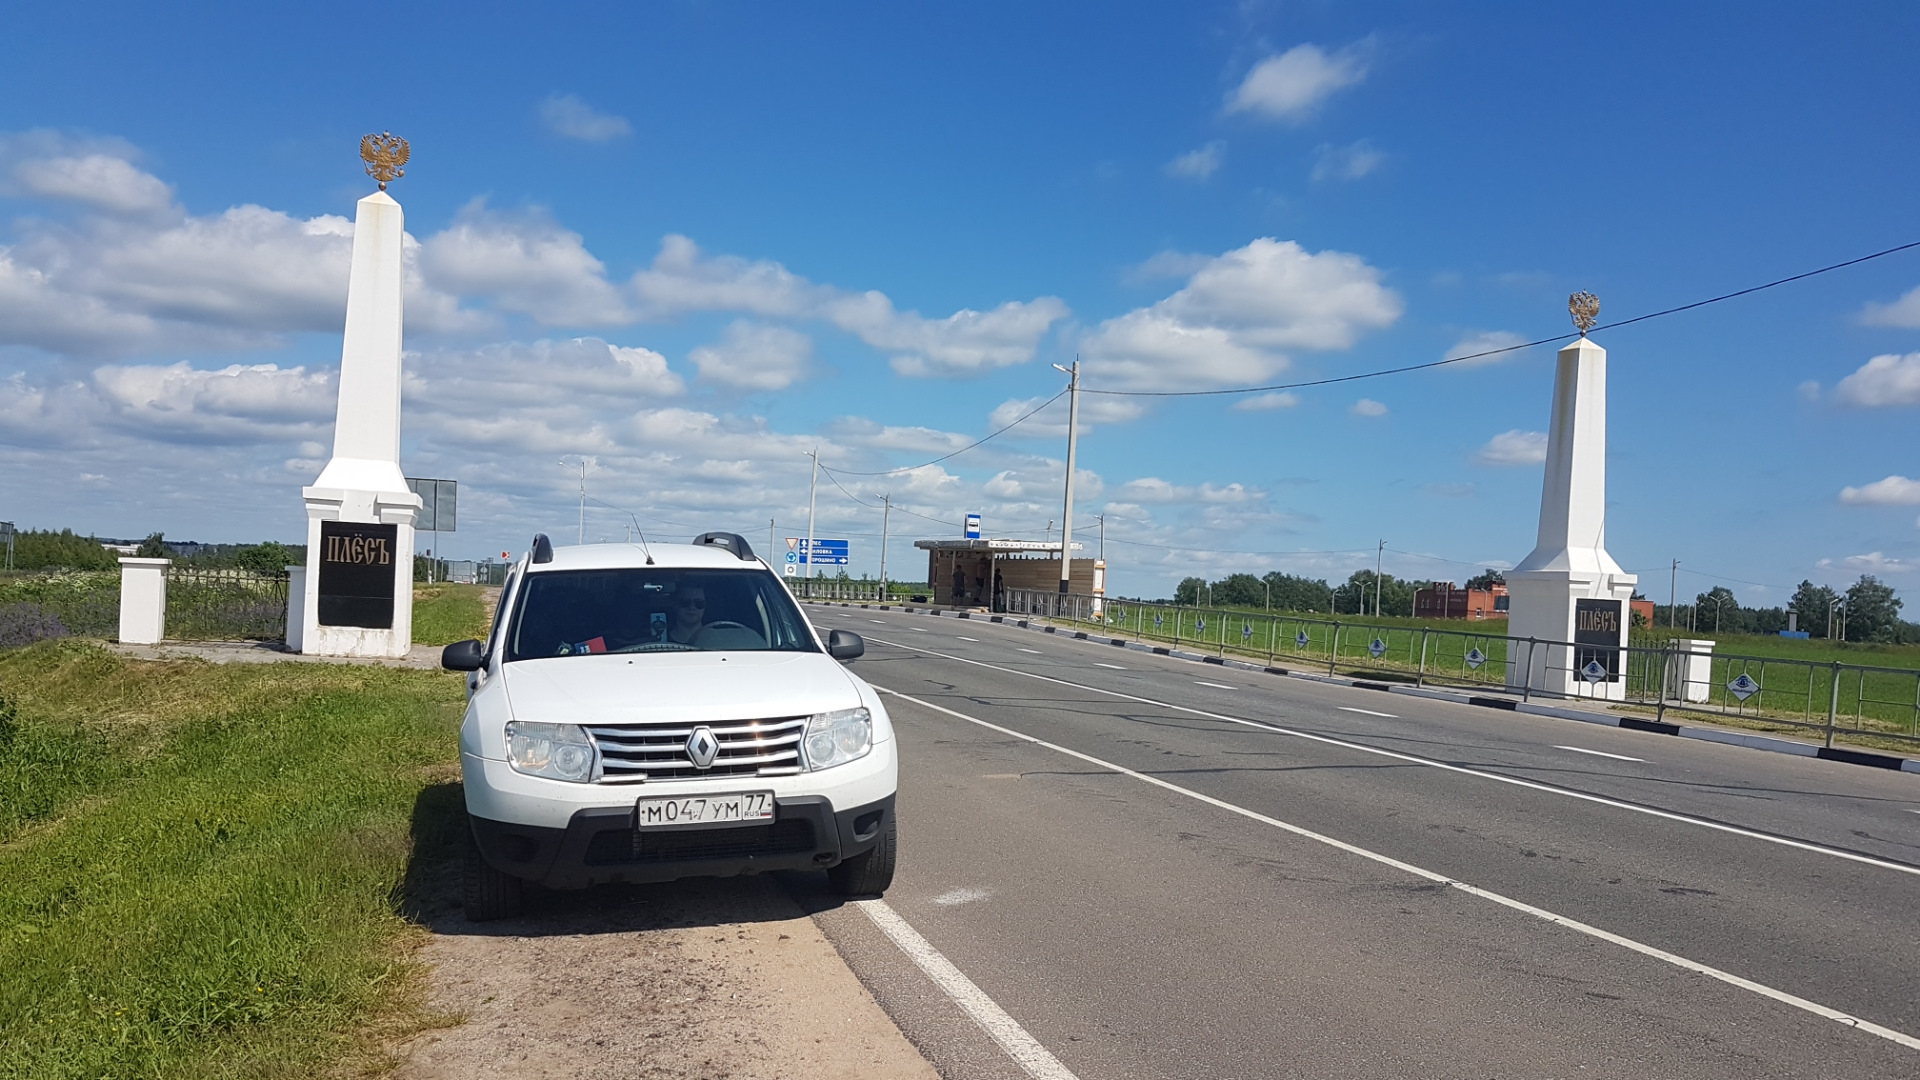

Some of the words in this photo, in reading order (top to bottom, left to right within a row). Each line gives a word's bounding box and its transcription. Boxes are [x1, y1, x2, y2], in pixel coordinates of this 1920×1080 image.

[326, 533, 390, 565] ПЛЁСЪ
[1579, 608, 1617, 632] ПЛЁСЪ
[745, 794, 766, 811] 77
